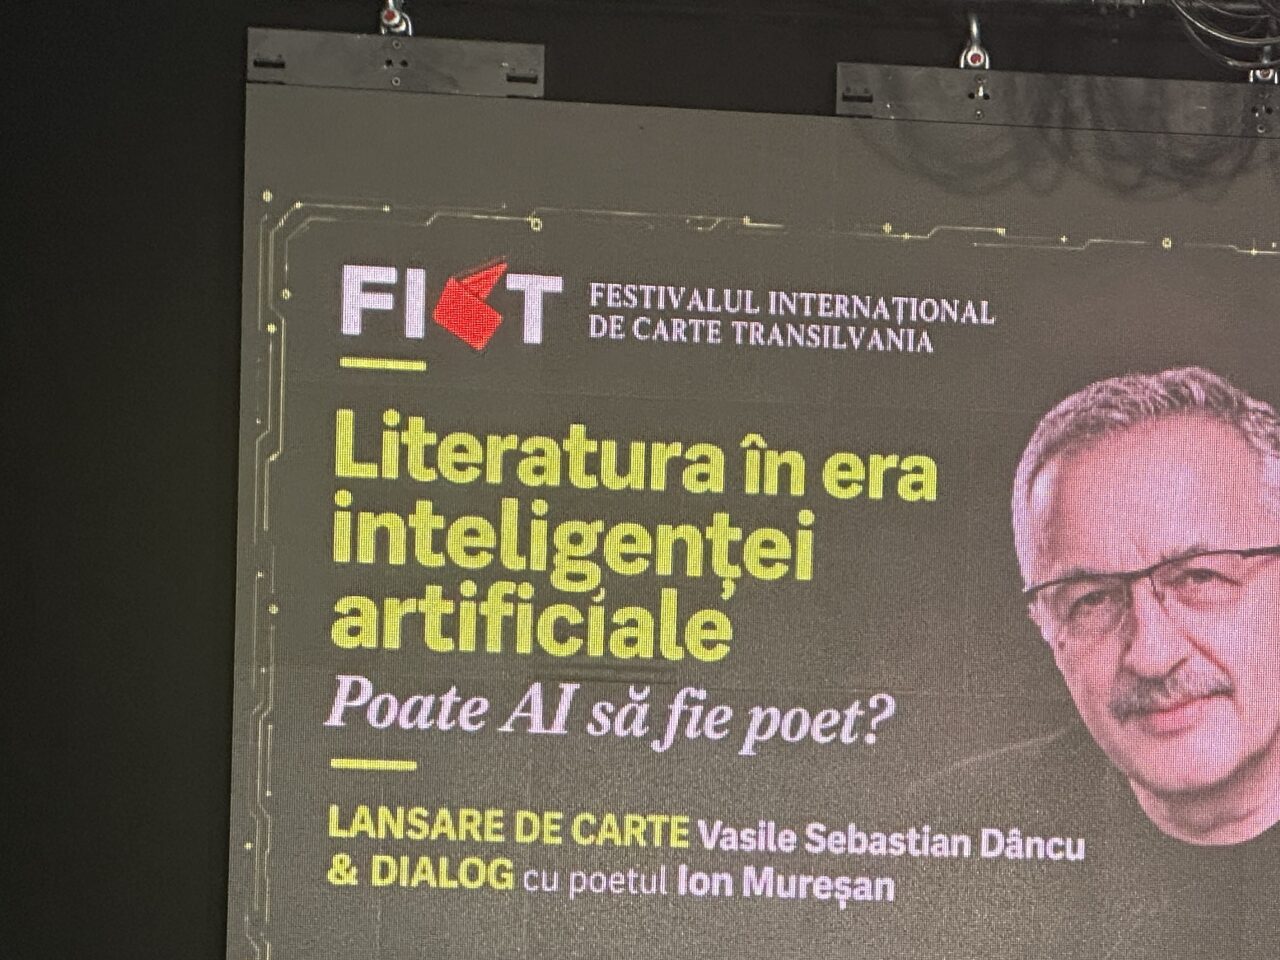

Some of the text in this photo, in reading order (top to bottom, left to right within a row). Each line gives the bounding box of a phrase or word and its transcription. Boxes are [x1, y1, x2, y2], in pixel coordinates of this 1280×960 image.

[588, 314, 935, 354] DE CARTE TRANSILVANIA
[589, 282, 996, 326] FESTIVALUL INTERNAȚIONAL
[334, 408, 939, 502] Literatura în era
[332, 489, 816, 601] inteligenței
[330, 579, 734, 663] artificiale
[323, 674, 897, 756] Poate AI să fie poet?
[328, 804, 1086, 861] LANSARE DE CARTE Vasile Sebastian Dâncu
[327, 853, 896, 911] & DIALOG cu poetul Ion Mureșan
